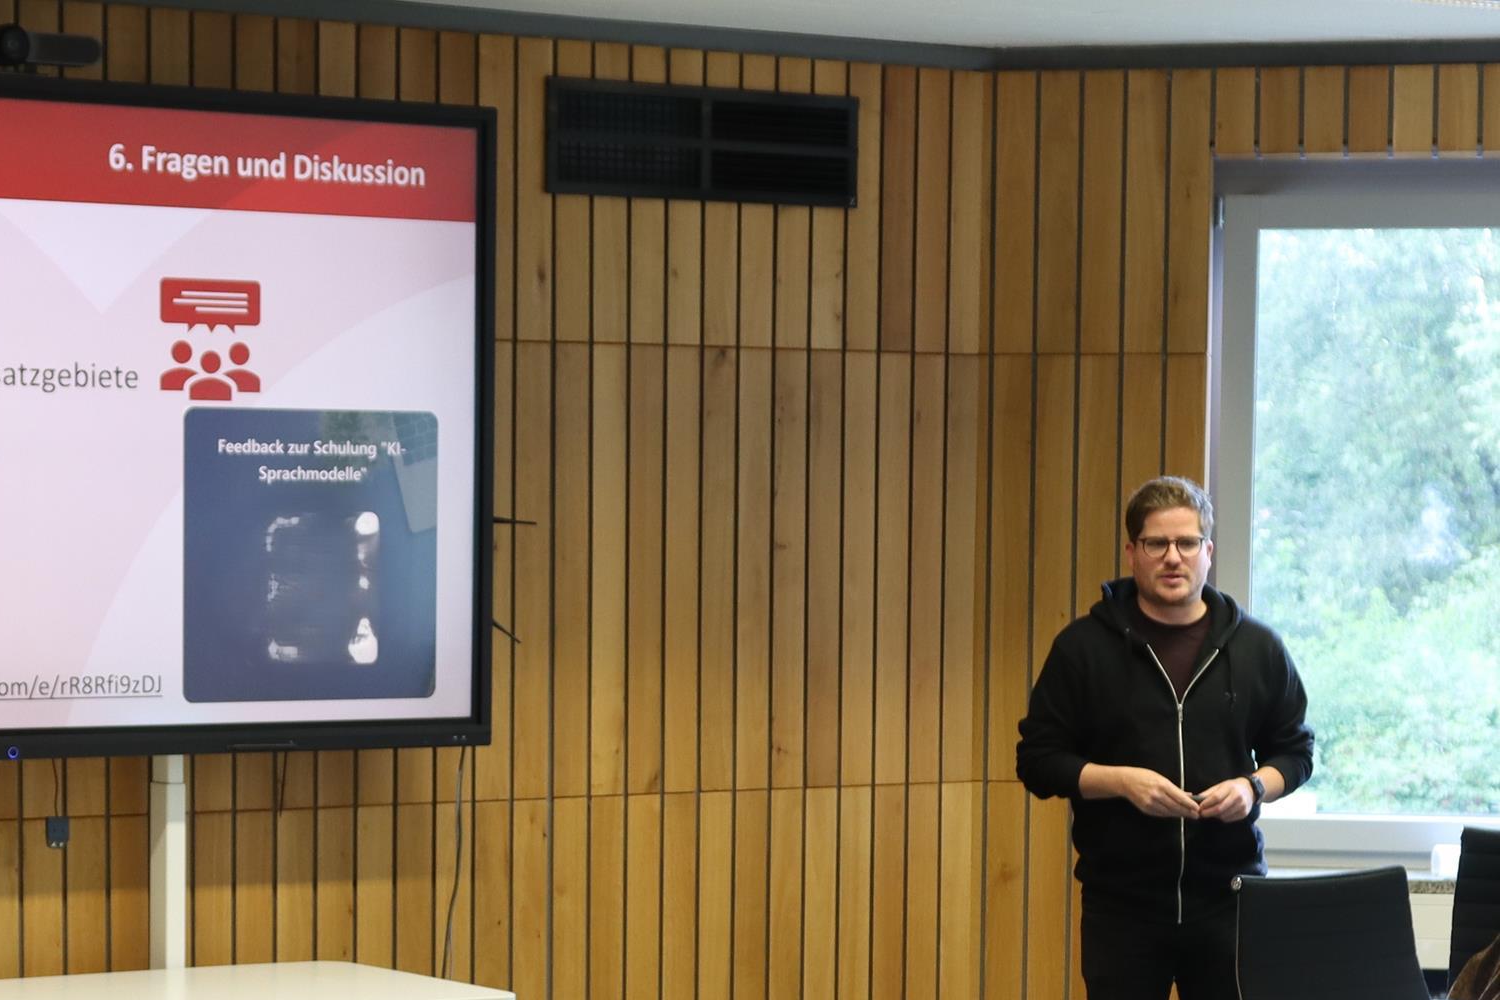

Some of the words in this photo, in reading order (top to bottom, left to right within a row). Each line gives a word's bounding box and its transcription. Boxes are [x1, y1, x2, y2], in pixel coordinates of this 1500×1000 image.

[108, 143, 134, 171] 6.
[141, 145, 230, 181] Fragen
[237, 151, 286, 179] und
[293, 154, 426, 187] Diskussion
[217, 438, 285, 455] Feedback
[286, 443, 311, 456] zur
[313, 439, 378, 460] Schulung
[258, 465, 368, 485] Sprachmodelle"
